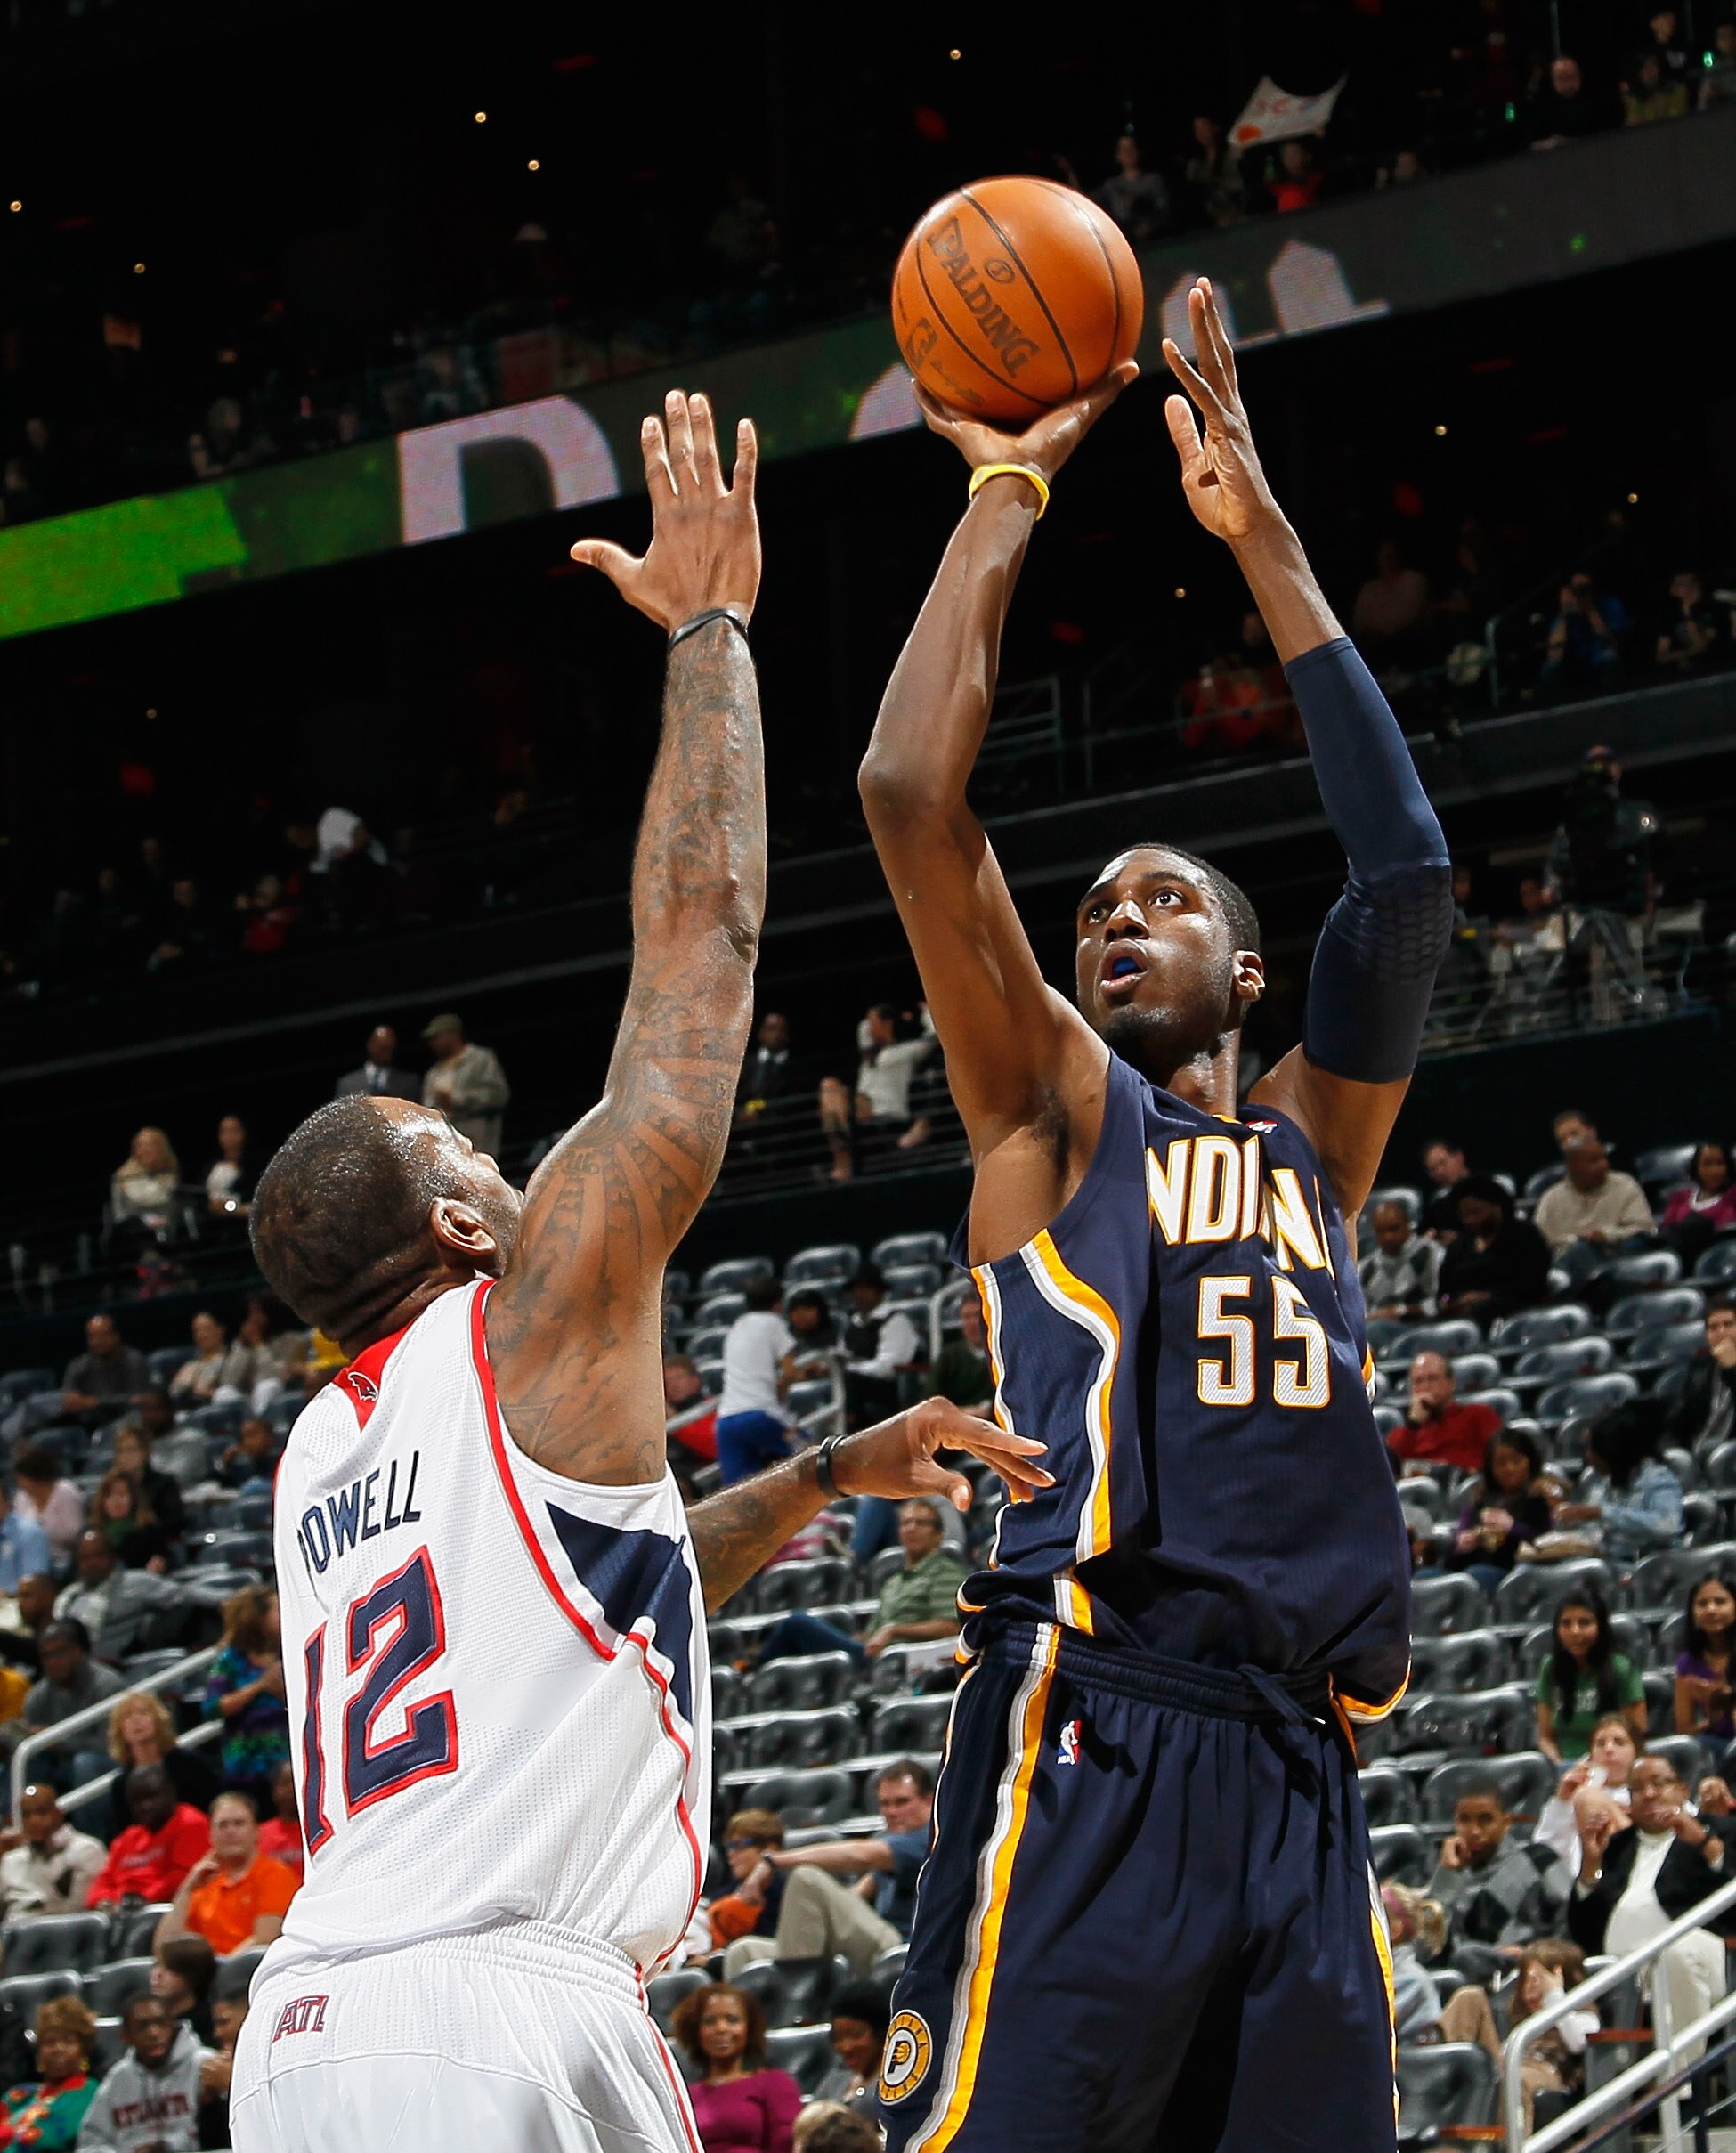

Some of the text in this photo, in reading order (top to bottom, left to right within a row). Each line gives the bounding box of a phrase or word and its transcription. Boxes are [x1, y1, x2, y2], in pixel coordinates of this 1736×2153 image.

[926, 217, 1041, 378] SPALDING
[1197, 1275, 1331, 1409] 55
[296, 1450, 423, 1574] OWELL
[303, 1544, 459, 1859] 12
[270, 1994, 330, 2045] ATL
